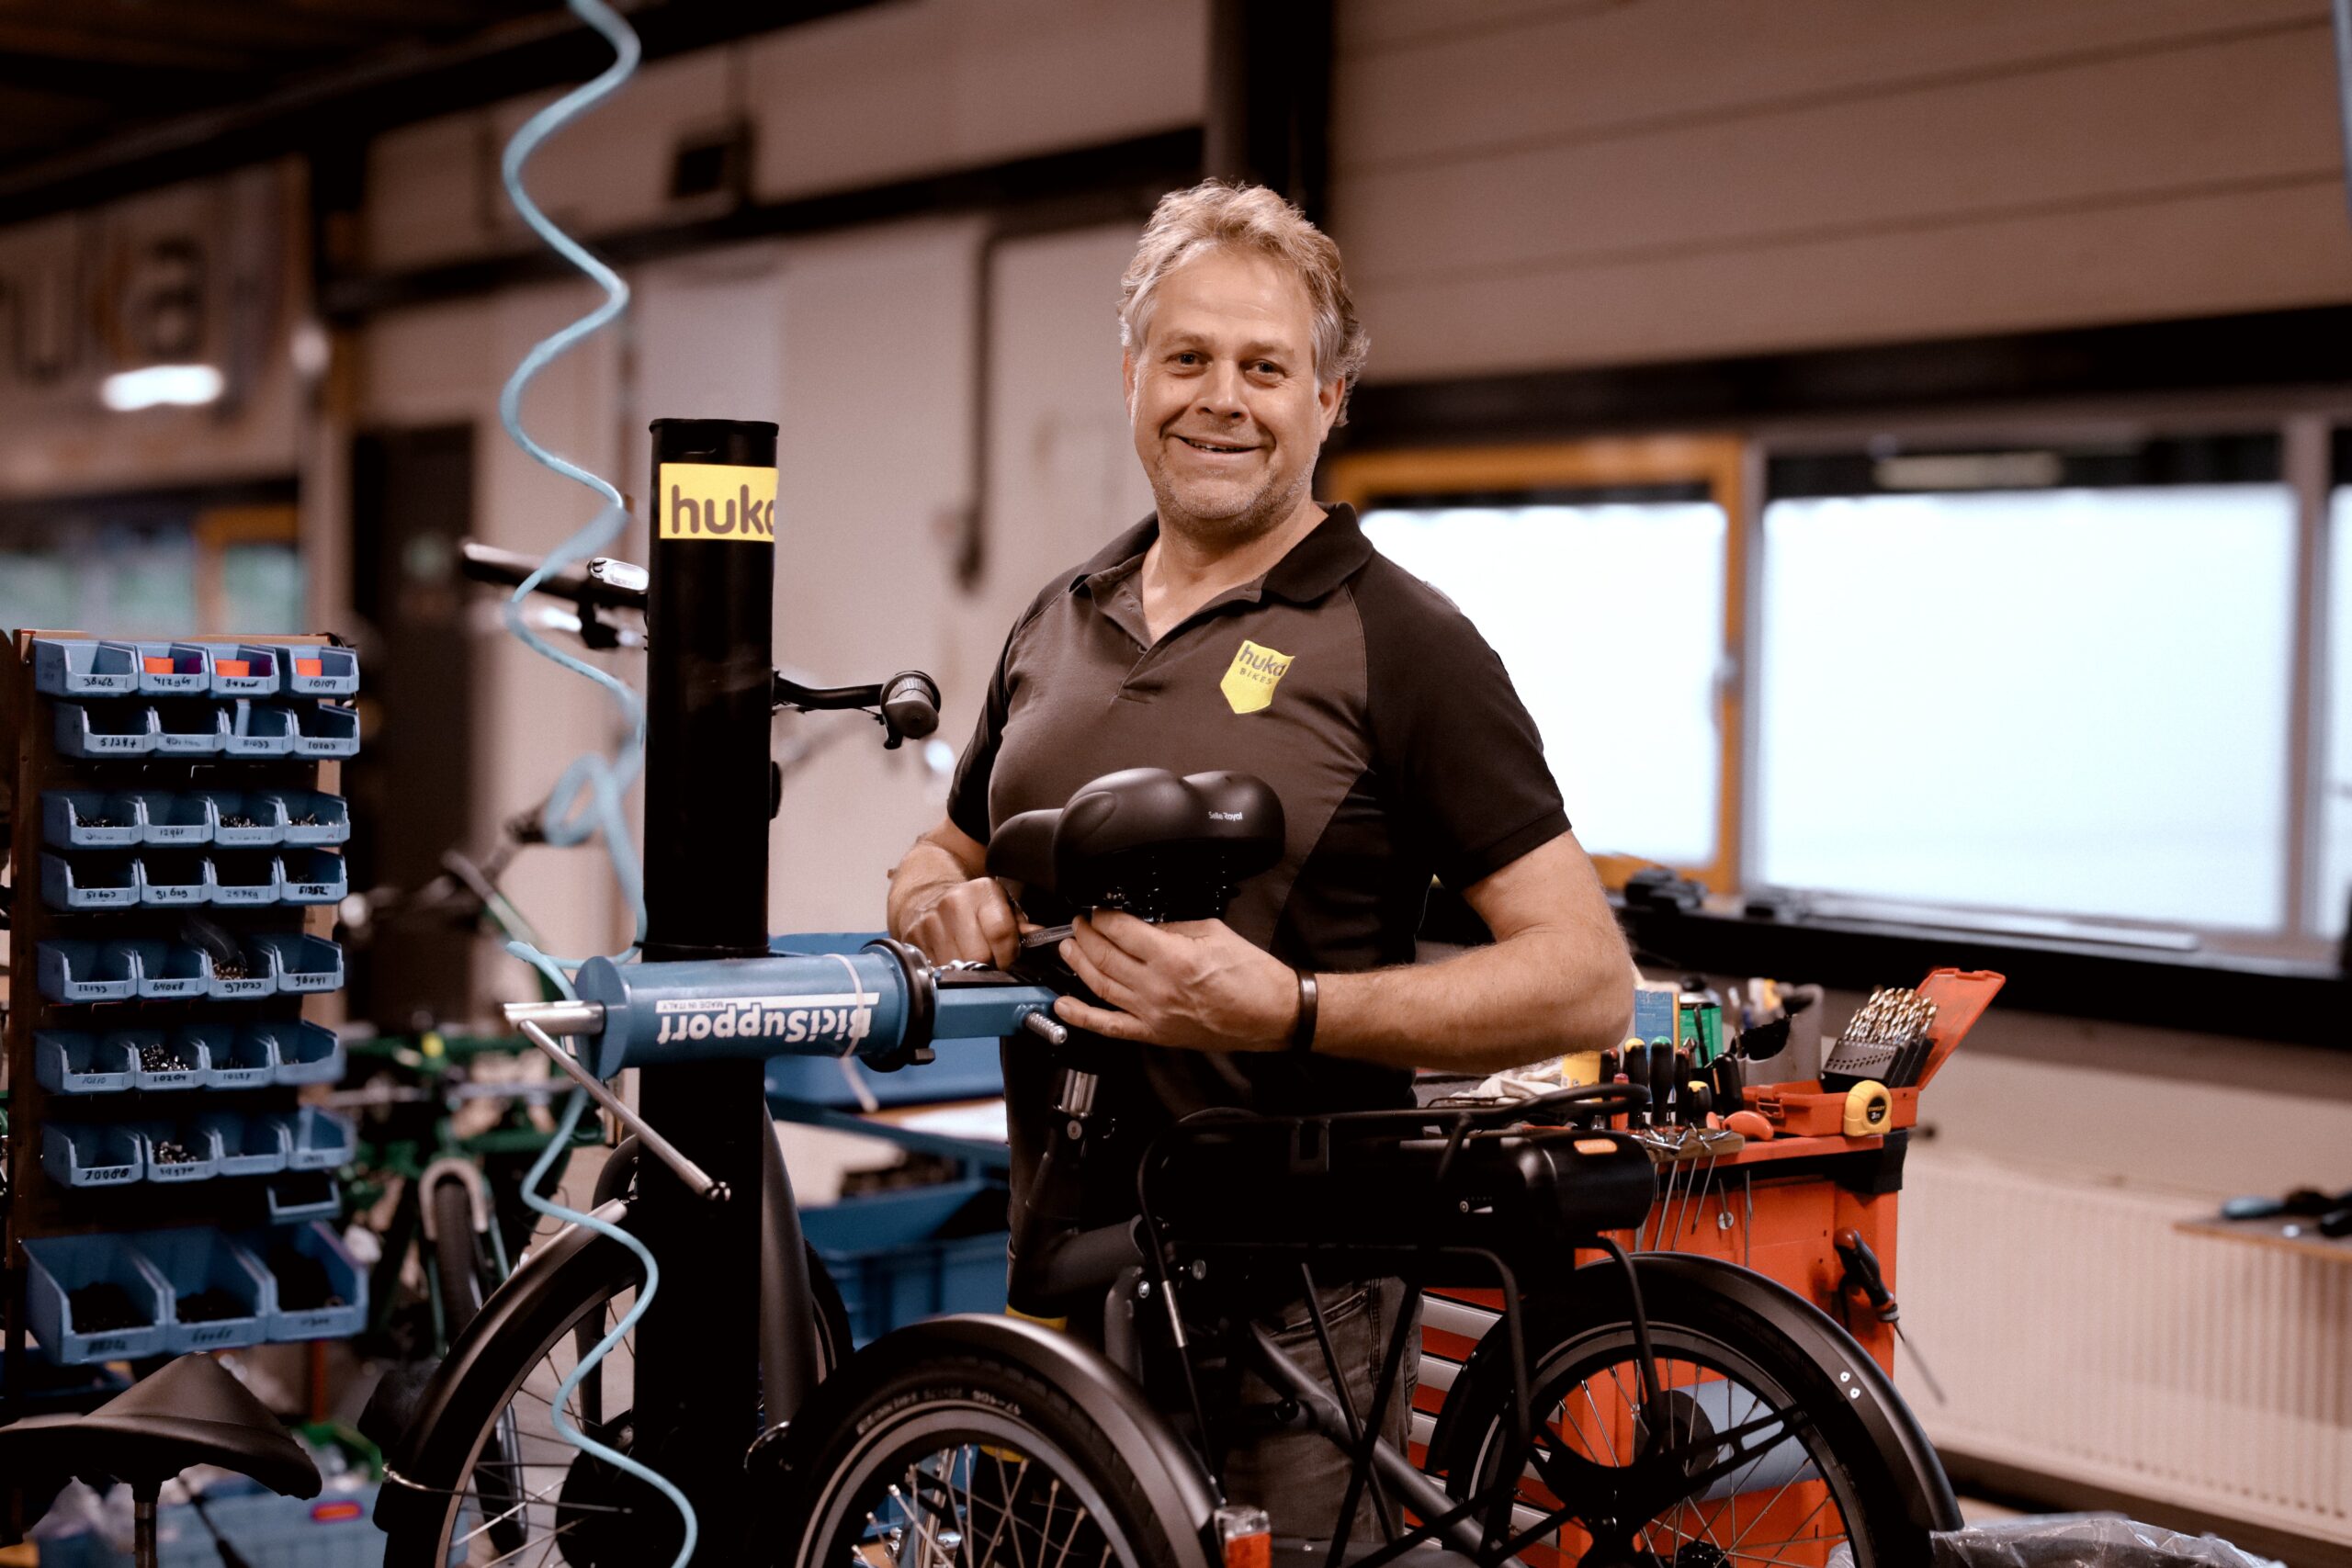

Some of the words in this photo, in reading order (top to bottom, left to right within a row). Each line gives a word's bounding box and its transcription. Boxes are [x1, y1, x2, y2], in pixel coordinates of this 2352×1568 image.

[662, 1002, 685, 1010] ITALY
[700, 1000, 724, 1010] MADE
[657, 1003, 872, 1045] BiciSupport
